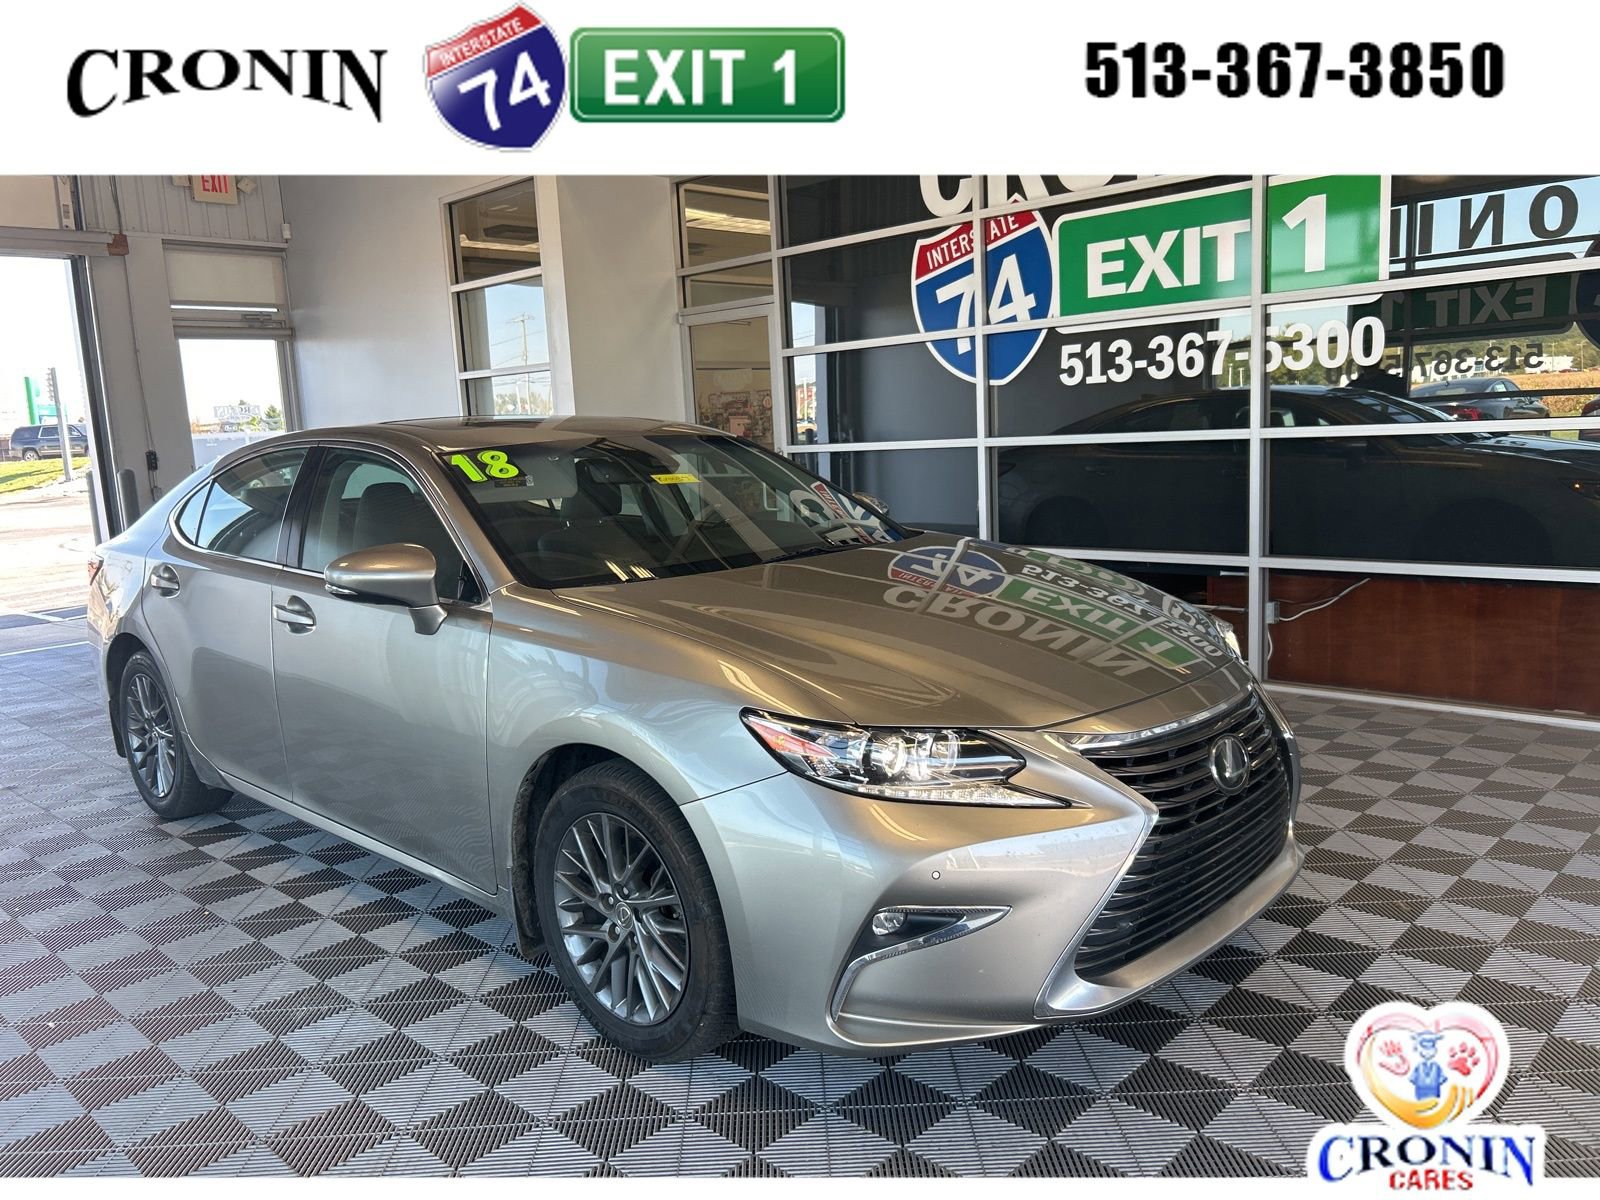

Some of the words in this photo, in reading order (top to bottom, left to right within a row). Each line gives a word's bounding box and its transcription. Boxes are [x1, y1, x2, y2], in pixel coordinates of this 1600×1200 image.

[200, 174, 229, 194] EXIT
[1087, 218, 1250, 299] EXIT
[1281, 193, 1327, 273] 1
[935, 253, 1037, 355] 74
[451, 450, 519, 482] 18
